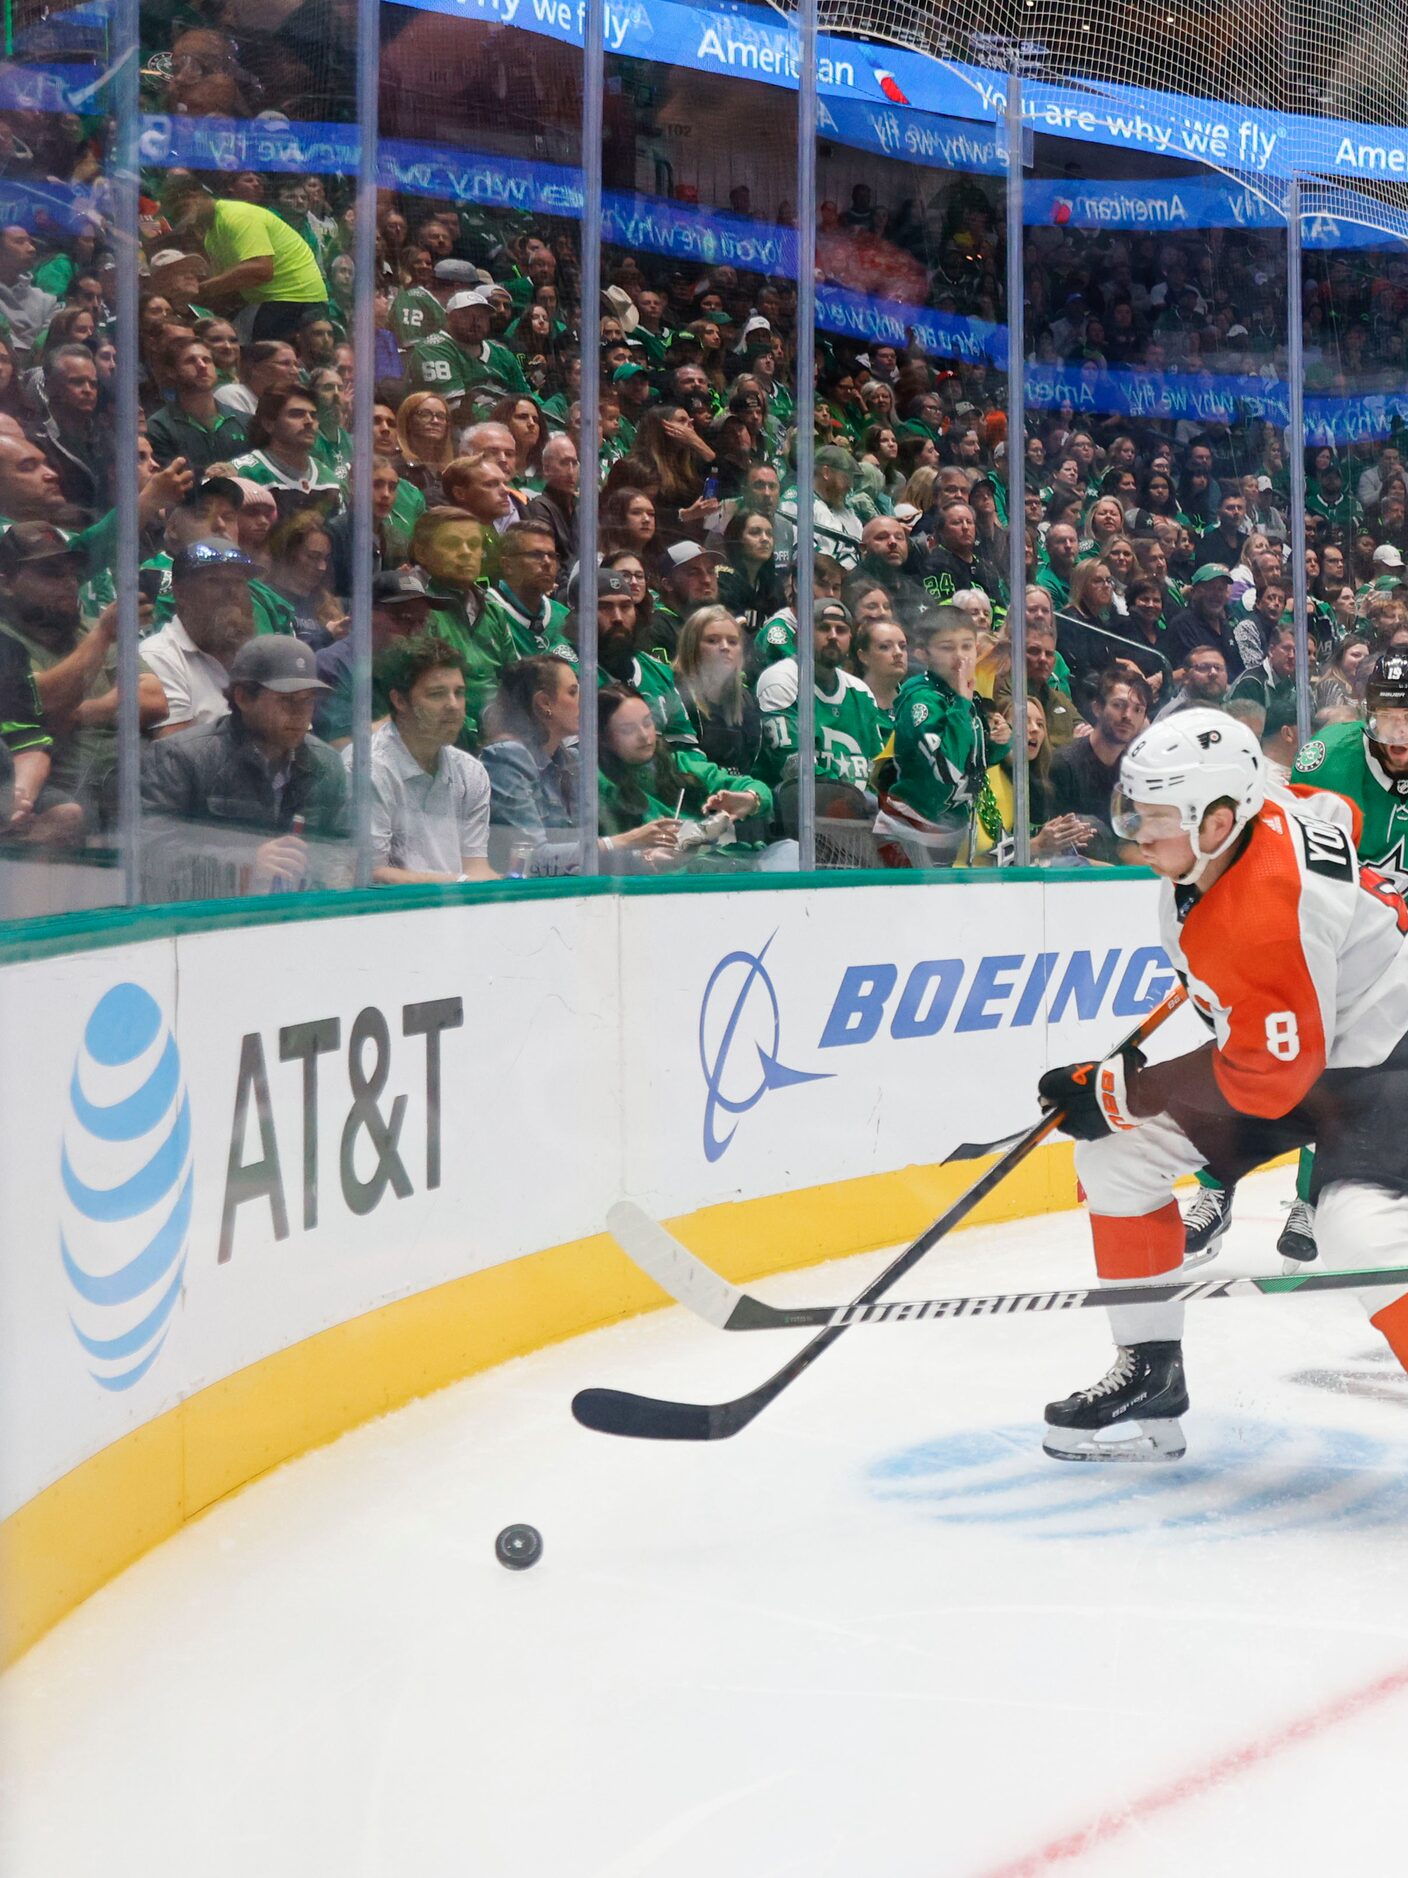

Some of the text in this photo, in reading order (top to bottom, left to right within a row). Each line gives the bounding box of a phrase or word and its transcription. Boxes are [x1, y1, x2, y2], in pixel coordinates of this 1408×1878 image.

[532, 0, 572, 31] we
[976, 82, 1036, 121] You
[1045, 104, 1097, 132] are
[1106, 108, 1172, 151] why
[1181, 119, 1230, 157] we
[818, 945, 1176, 1049] BOEING
[1264, 1011, 1300, 1062] 8
[217, 996, 463, 1265] AT&T
[827, 1290, 1090, 1328] WARRIOR
